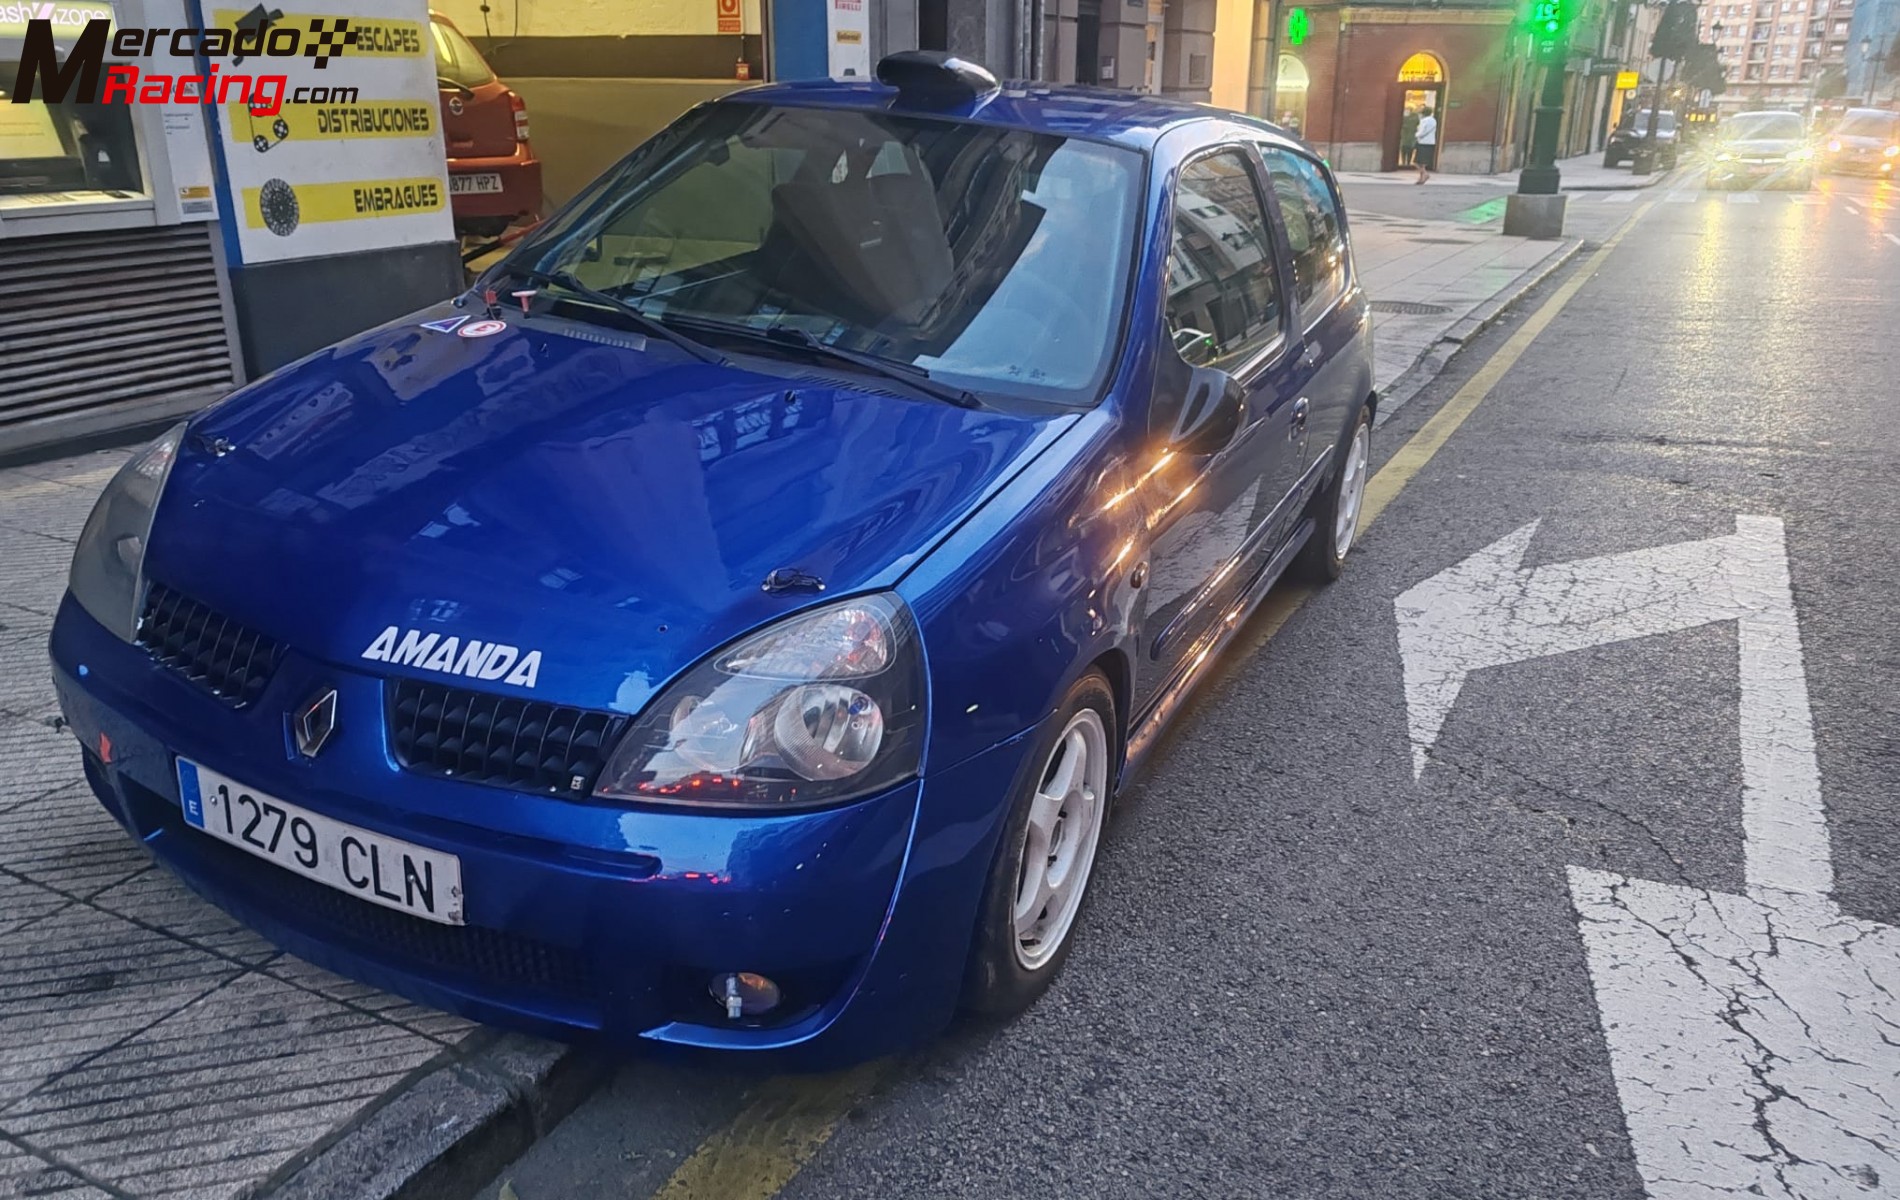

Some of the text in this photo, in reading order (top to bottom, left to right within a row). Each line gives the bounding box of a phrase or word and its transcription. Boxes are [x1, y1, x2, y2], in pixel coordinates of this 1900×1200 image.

[56, 8, 107, 25] zone
[355, 26, 420, 52] ESCAPES
[317, 108, 430, 134] DISTRIBUCIONES
[448, 176, 499, 191] 877 HPZ
[353, 184, 438, 212] EMBRAGUES
[362, 626, 542, 688] AMANDA
[188, 800, 200, 816] E
[217, 784, 436, 914] 1279 CLN
